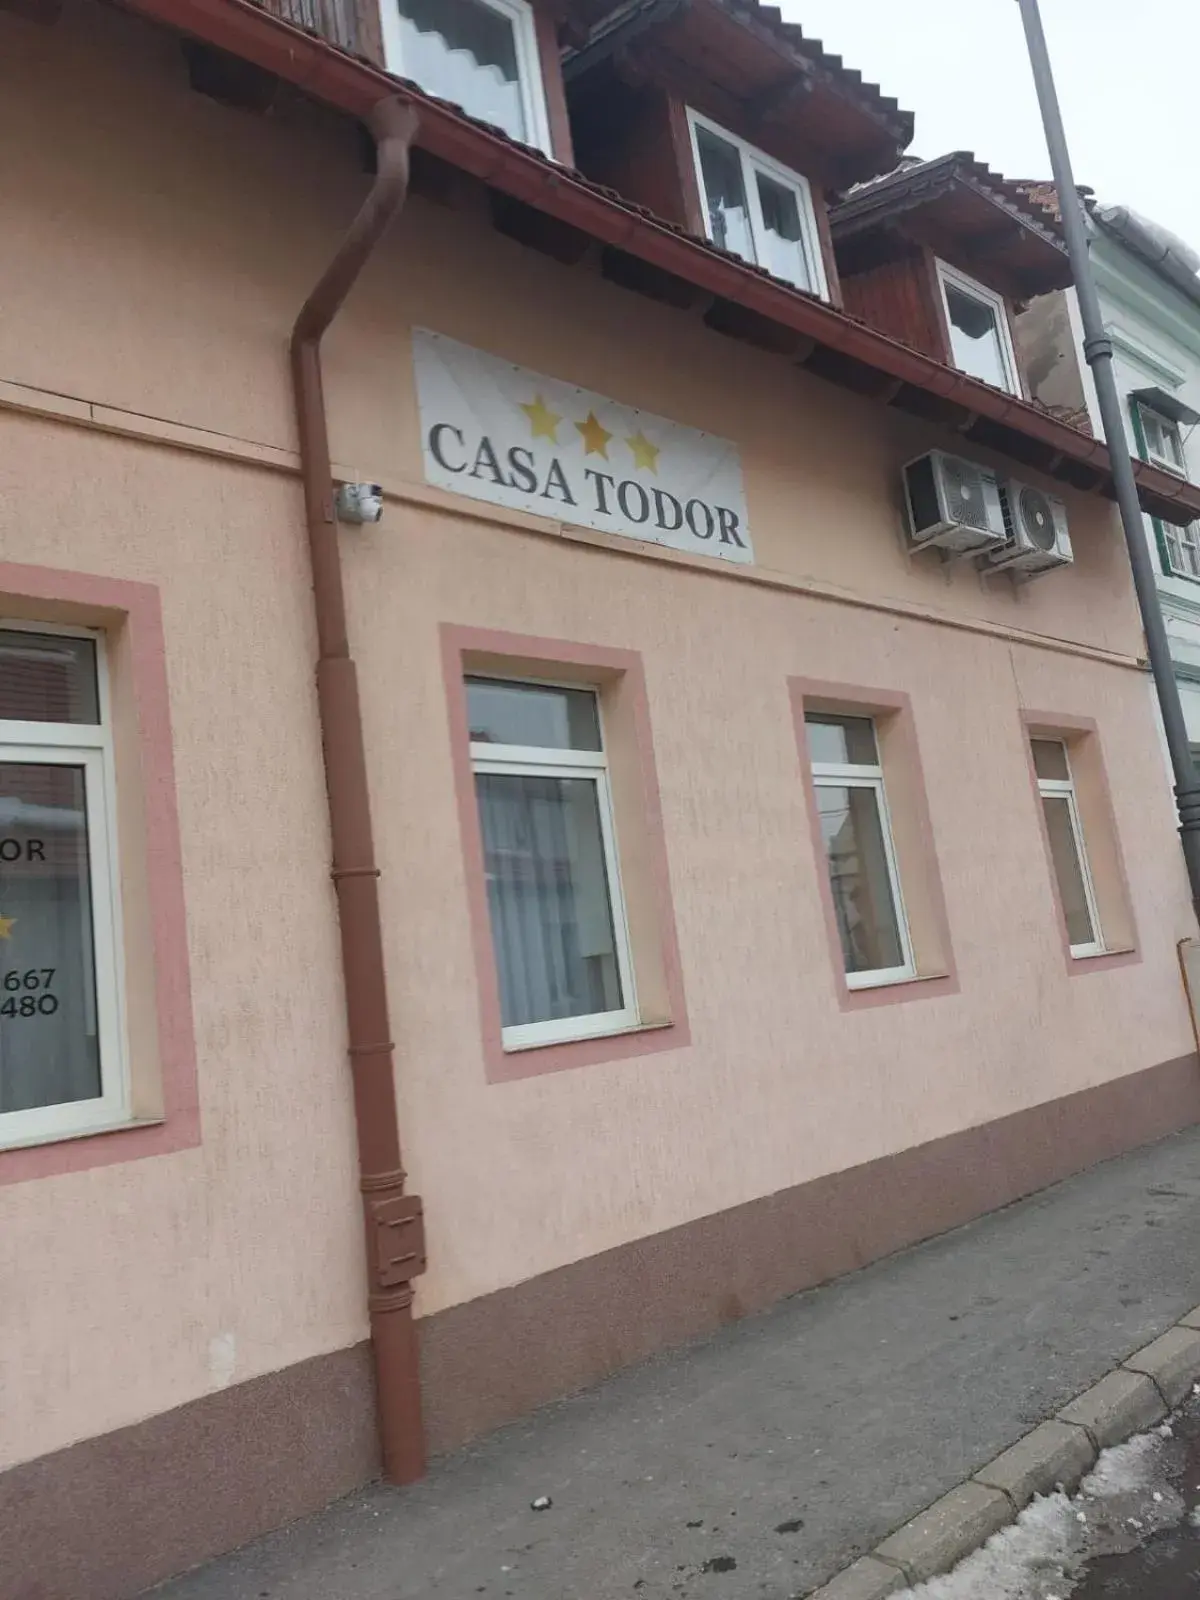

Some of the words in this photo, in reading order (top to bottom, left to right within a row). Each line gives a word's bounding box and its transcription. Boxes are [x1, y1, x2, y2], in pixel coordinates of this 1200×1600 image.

[429, 423, 577, 506] CASA
[584, 468, 747, 548] TODOR
[4, 968, 56, 991] 667
[0, 994, 58, 1018] 480
